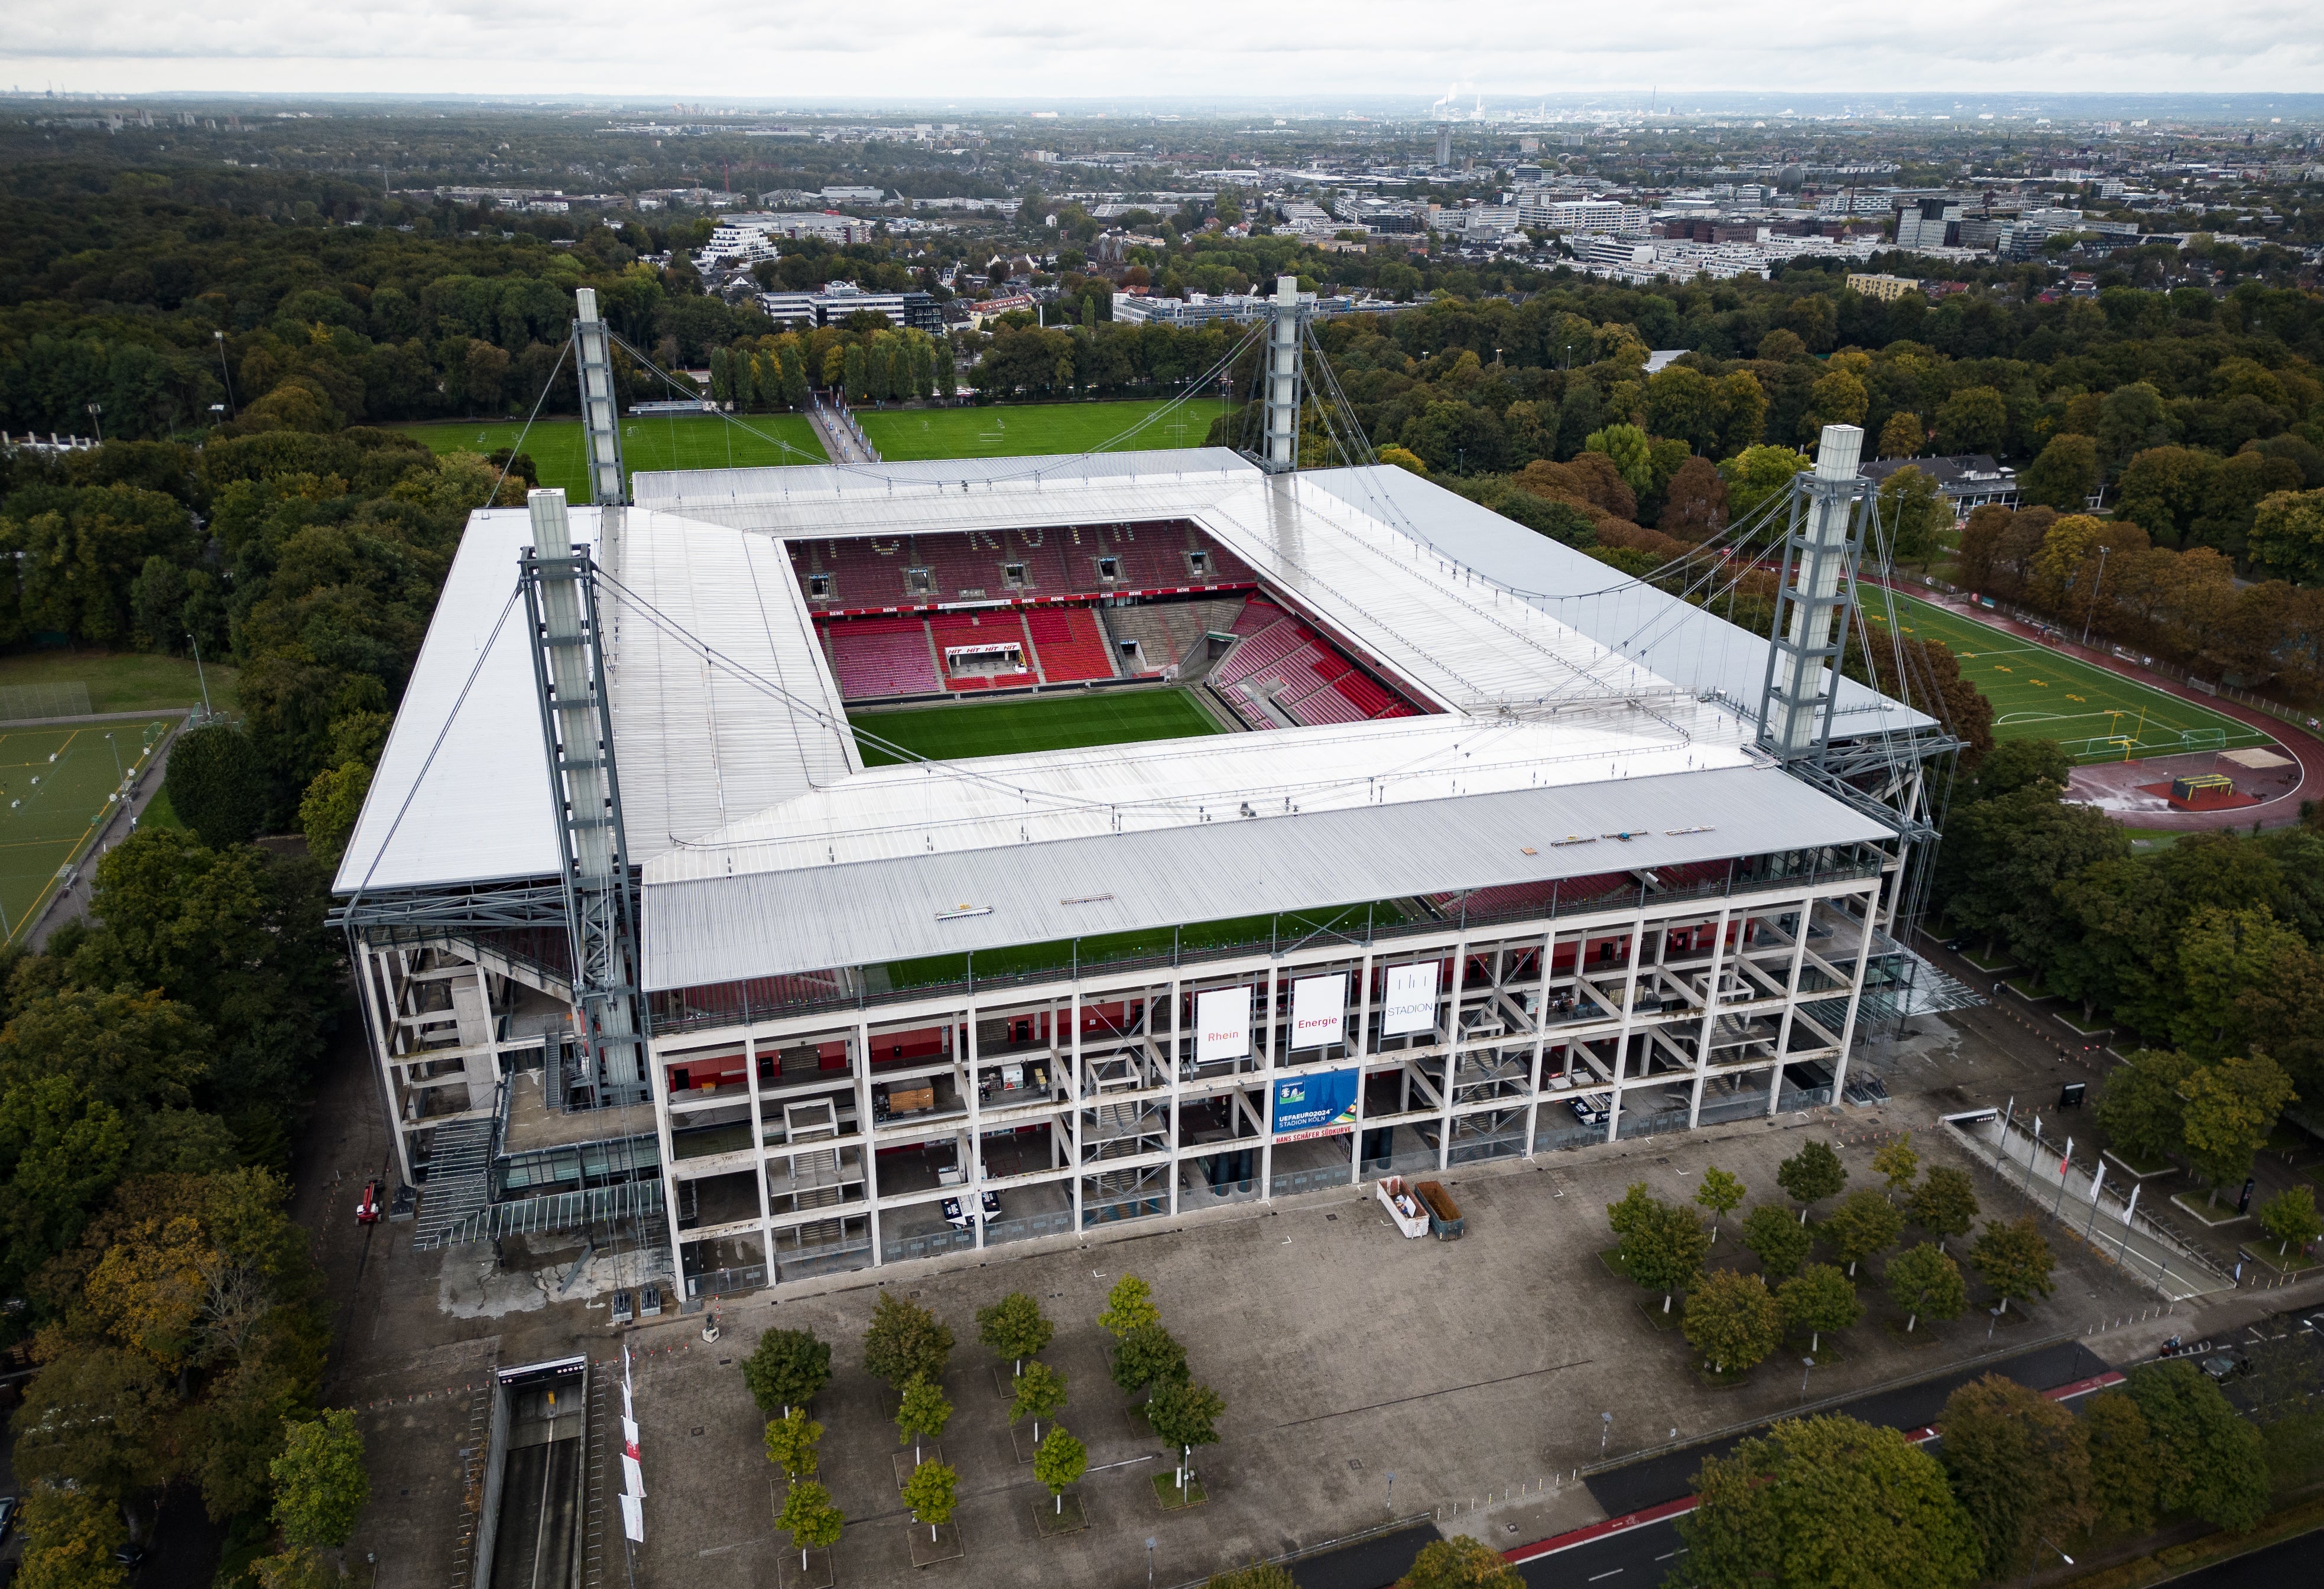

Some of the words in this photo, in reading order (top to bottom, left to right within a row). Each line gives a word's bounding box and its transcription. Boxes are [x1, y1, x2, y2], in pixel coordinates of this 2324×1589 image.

[1388, 1002, 1433, 1017] STADION
[1298, 1016, 1338, 1028] Energie
[1208, 1031, 1238, 1041] Rhein
[1279, 1119, 1308, 1128] STADION
[1293, 1131, 1320, 1140] SCHÄFER
[1322, 1126, 1352, 1136] SÜDKURVE
